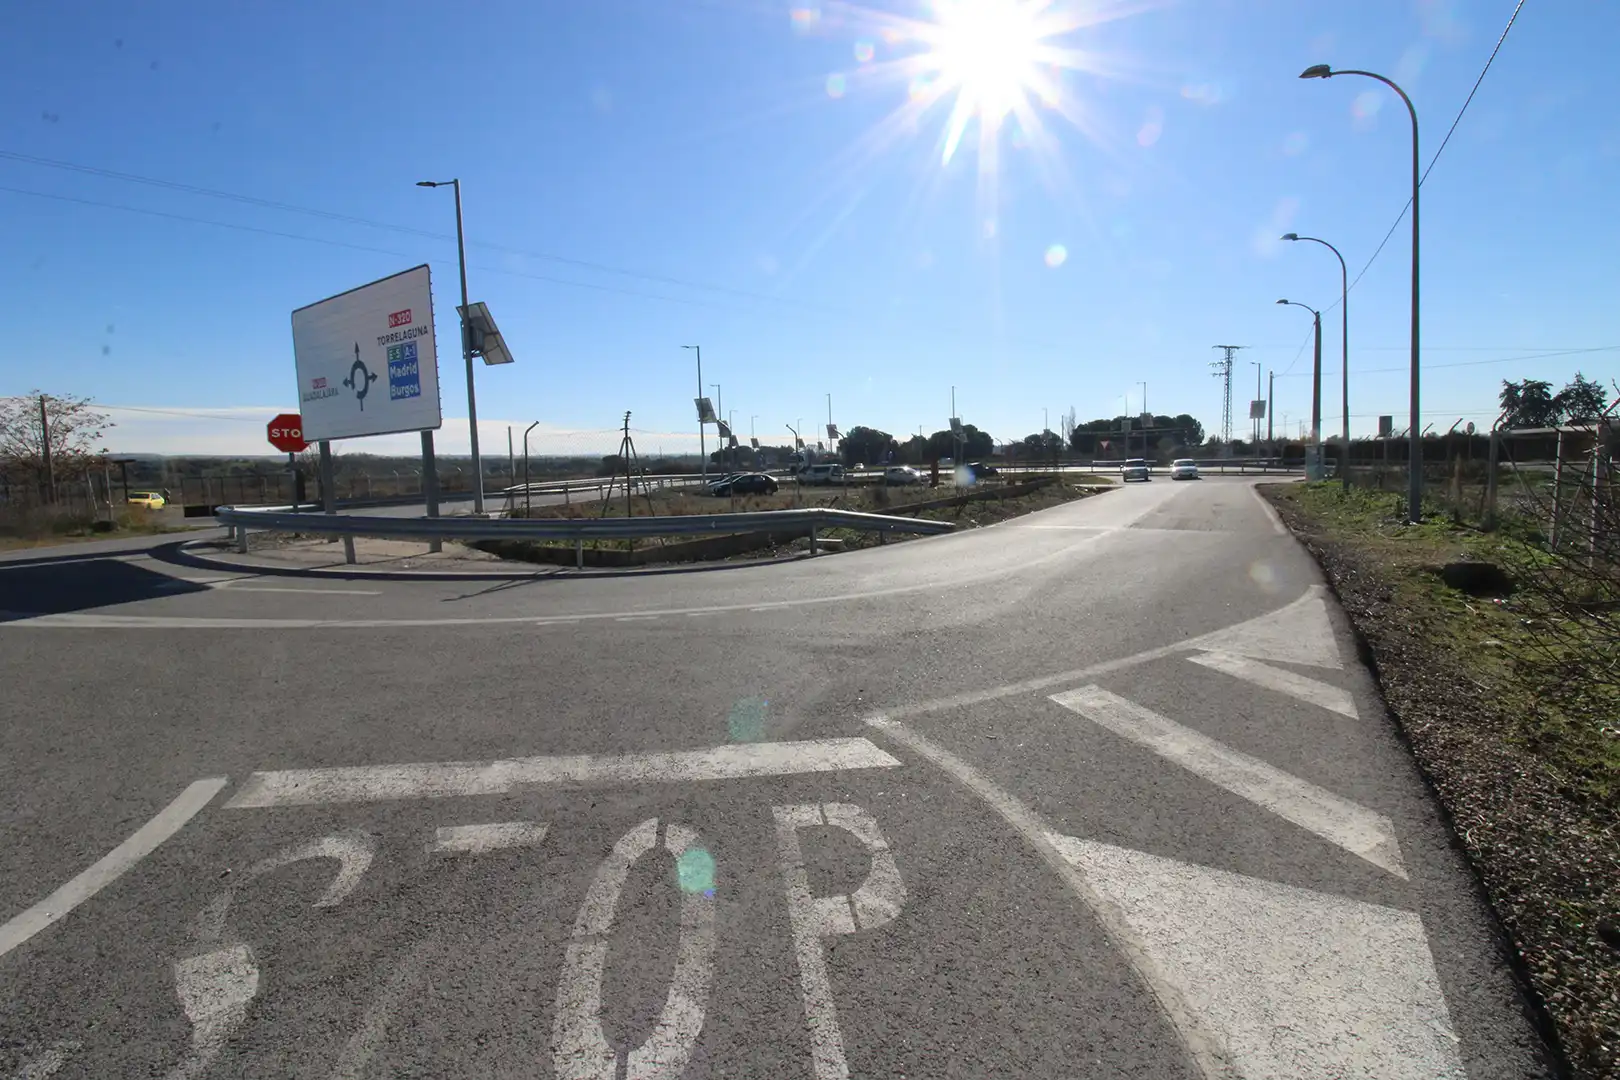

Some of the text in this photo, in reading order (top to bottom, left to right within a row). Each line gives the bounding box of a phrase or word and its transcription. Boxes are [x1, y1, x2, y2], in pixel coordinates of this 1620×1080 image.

[389, 311, 410, 327] N-320
[377, 325, 428, 346] TORRELAGUNA
[405, 345, 416, 357] A-1
[390, 362, 417, 379] Madrid
[391, 384, 419, 398] Burgos
[271, 428, 302, 438] STO
